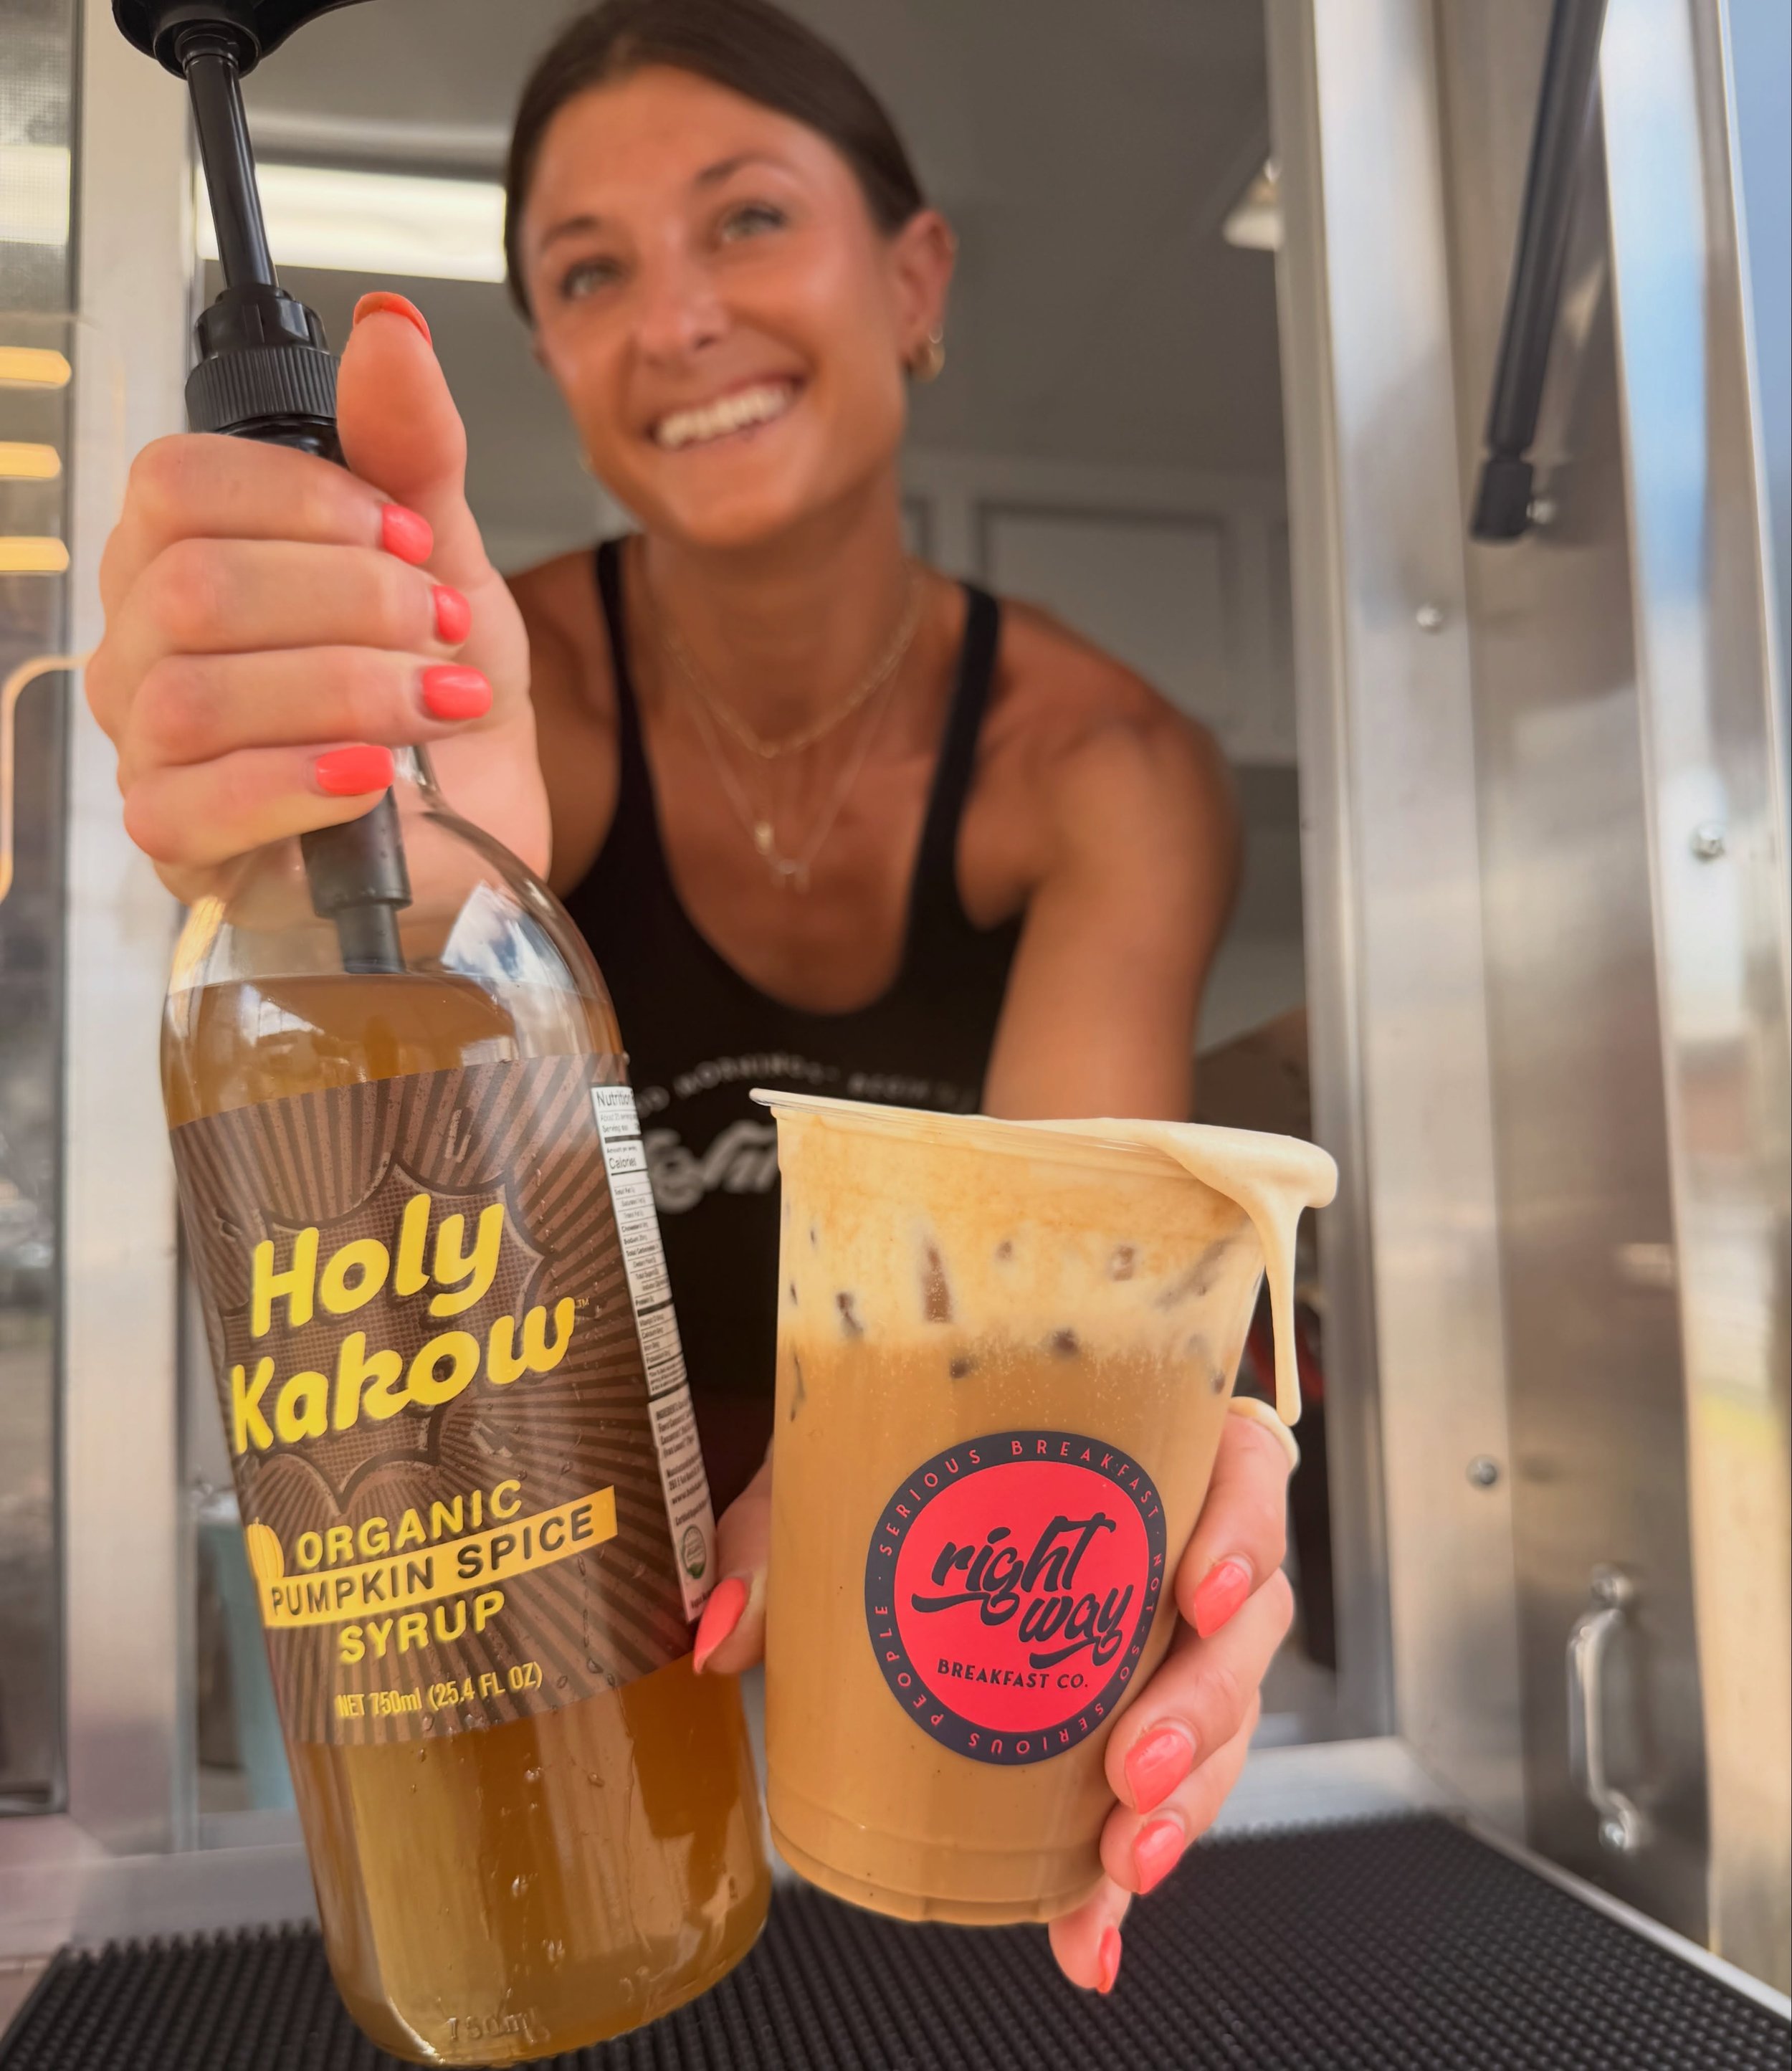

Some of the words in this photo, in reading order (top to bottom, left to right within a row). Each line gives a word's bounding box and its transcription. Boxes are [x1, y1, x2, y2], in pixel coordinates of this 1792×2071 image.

[252, 1193, 504, 1338] Holy
[231, 1297, 576, 1455] Kakow
[879, 1449, 981, 1556] SERIOUS
[1011, 1439, 1160, 1518] BREAKFAST
[271, 1556, 434, 1616] PUMPKIN
[456, 1503, 594, 1579] SPICE
[296, 1479, 523, 1569] ORGANIC
[338, 1591, 505, 1664] SYRUP
[874, 1605, 945, 1726] PEOPLE
[1018, 1584, 1134, 1670] way
[335, 1693, 365, 1718] NET
[369, 1687, 422, 1715] 750ml
[428, 1677, 475, 1712] (25.4
[479, 1672, 505, 1698] FL
[507, 1661, 543, 1690] OZ)
[937, 1658, 1049, 1689] BREAKFAST
[1057, 1672, 1089, 1690] CO.
[968, 1703, 1105, 1756] SERIOUS
